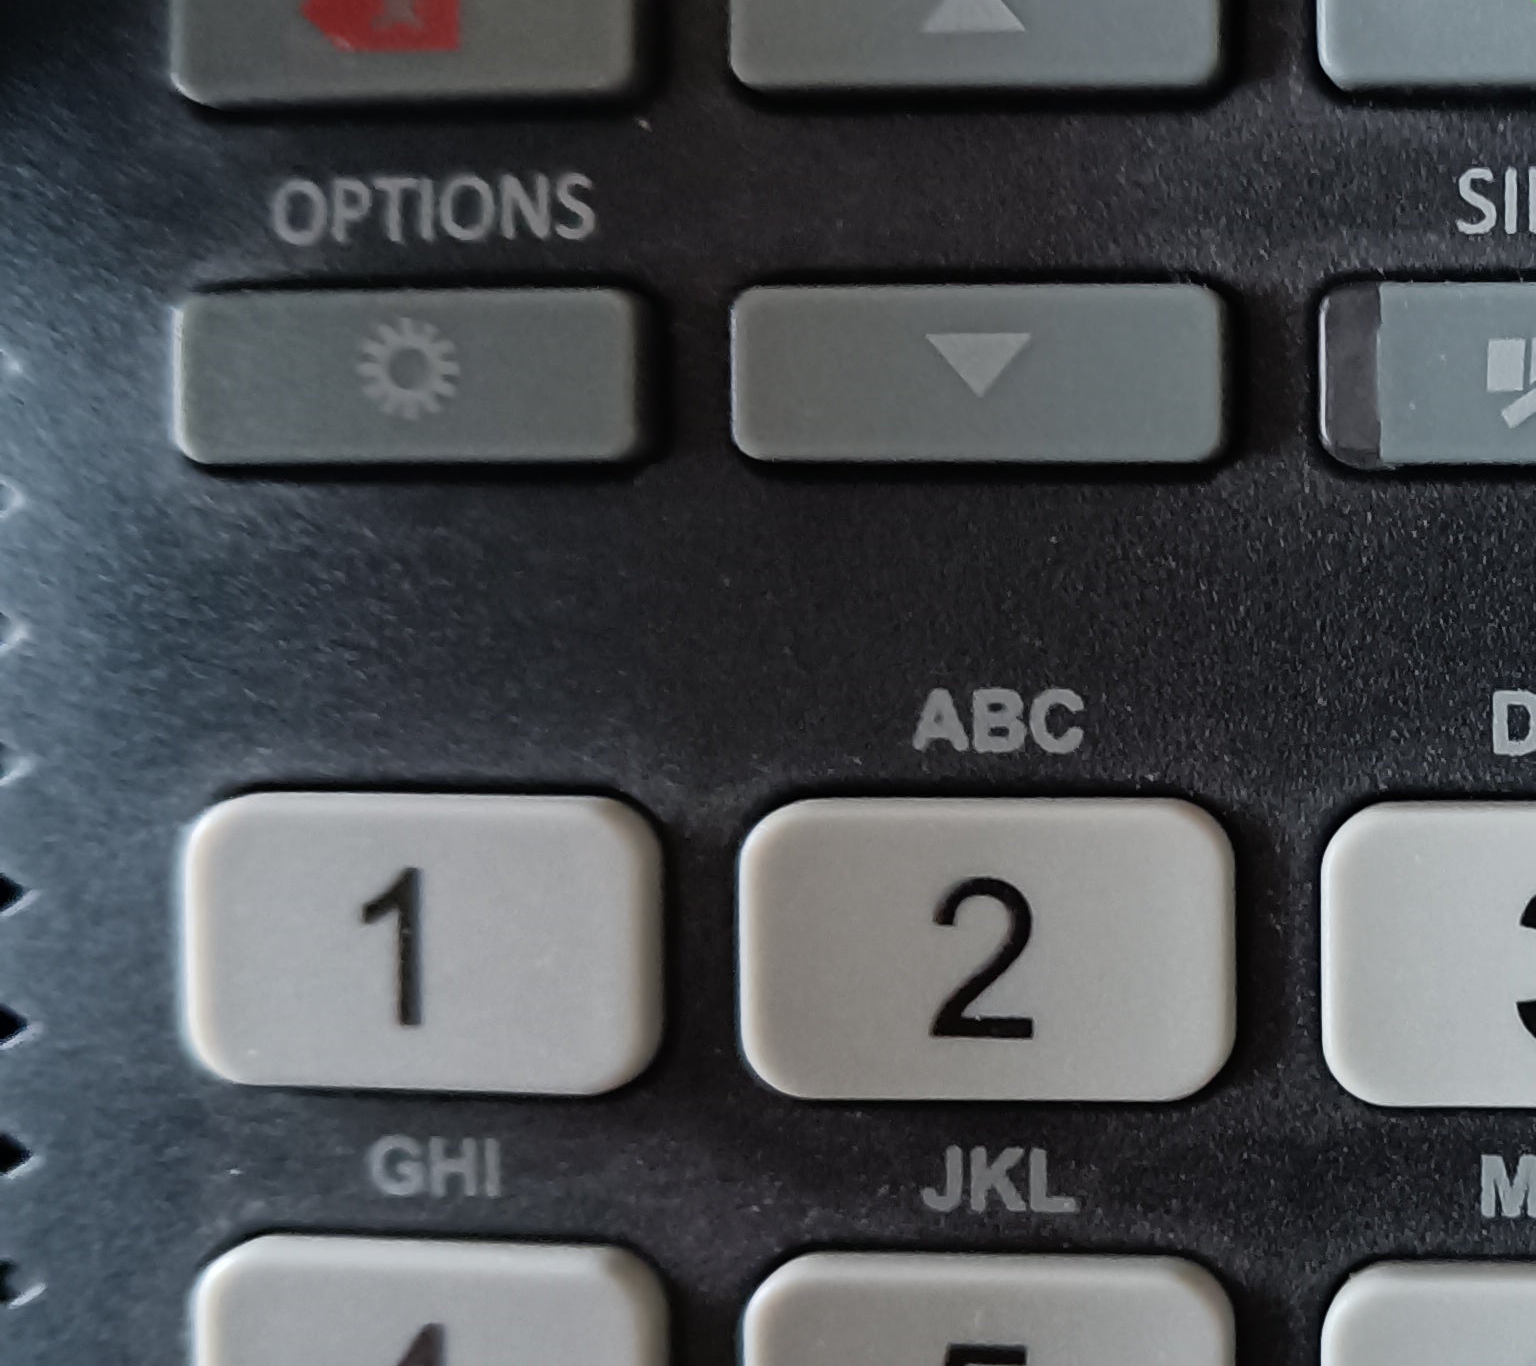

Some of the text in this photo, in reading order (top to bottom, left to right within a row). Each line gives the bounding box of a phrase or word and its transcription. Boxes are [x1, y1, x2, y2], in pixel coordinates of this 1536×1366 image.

[268, 173, 597, 247] OPTIONS
[913, 688, 1084, 754] ABC
[362, 867, 421, 1026] 1
[930, 877, 1035, 1039] 2
[365, 1135, 502, 1202] GHI
[921, 1146, 1079, 1215] JKL
